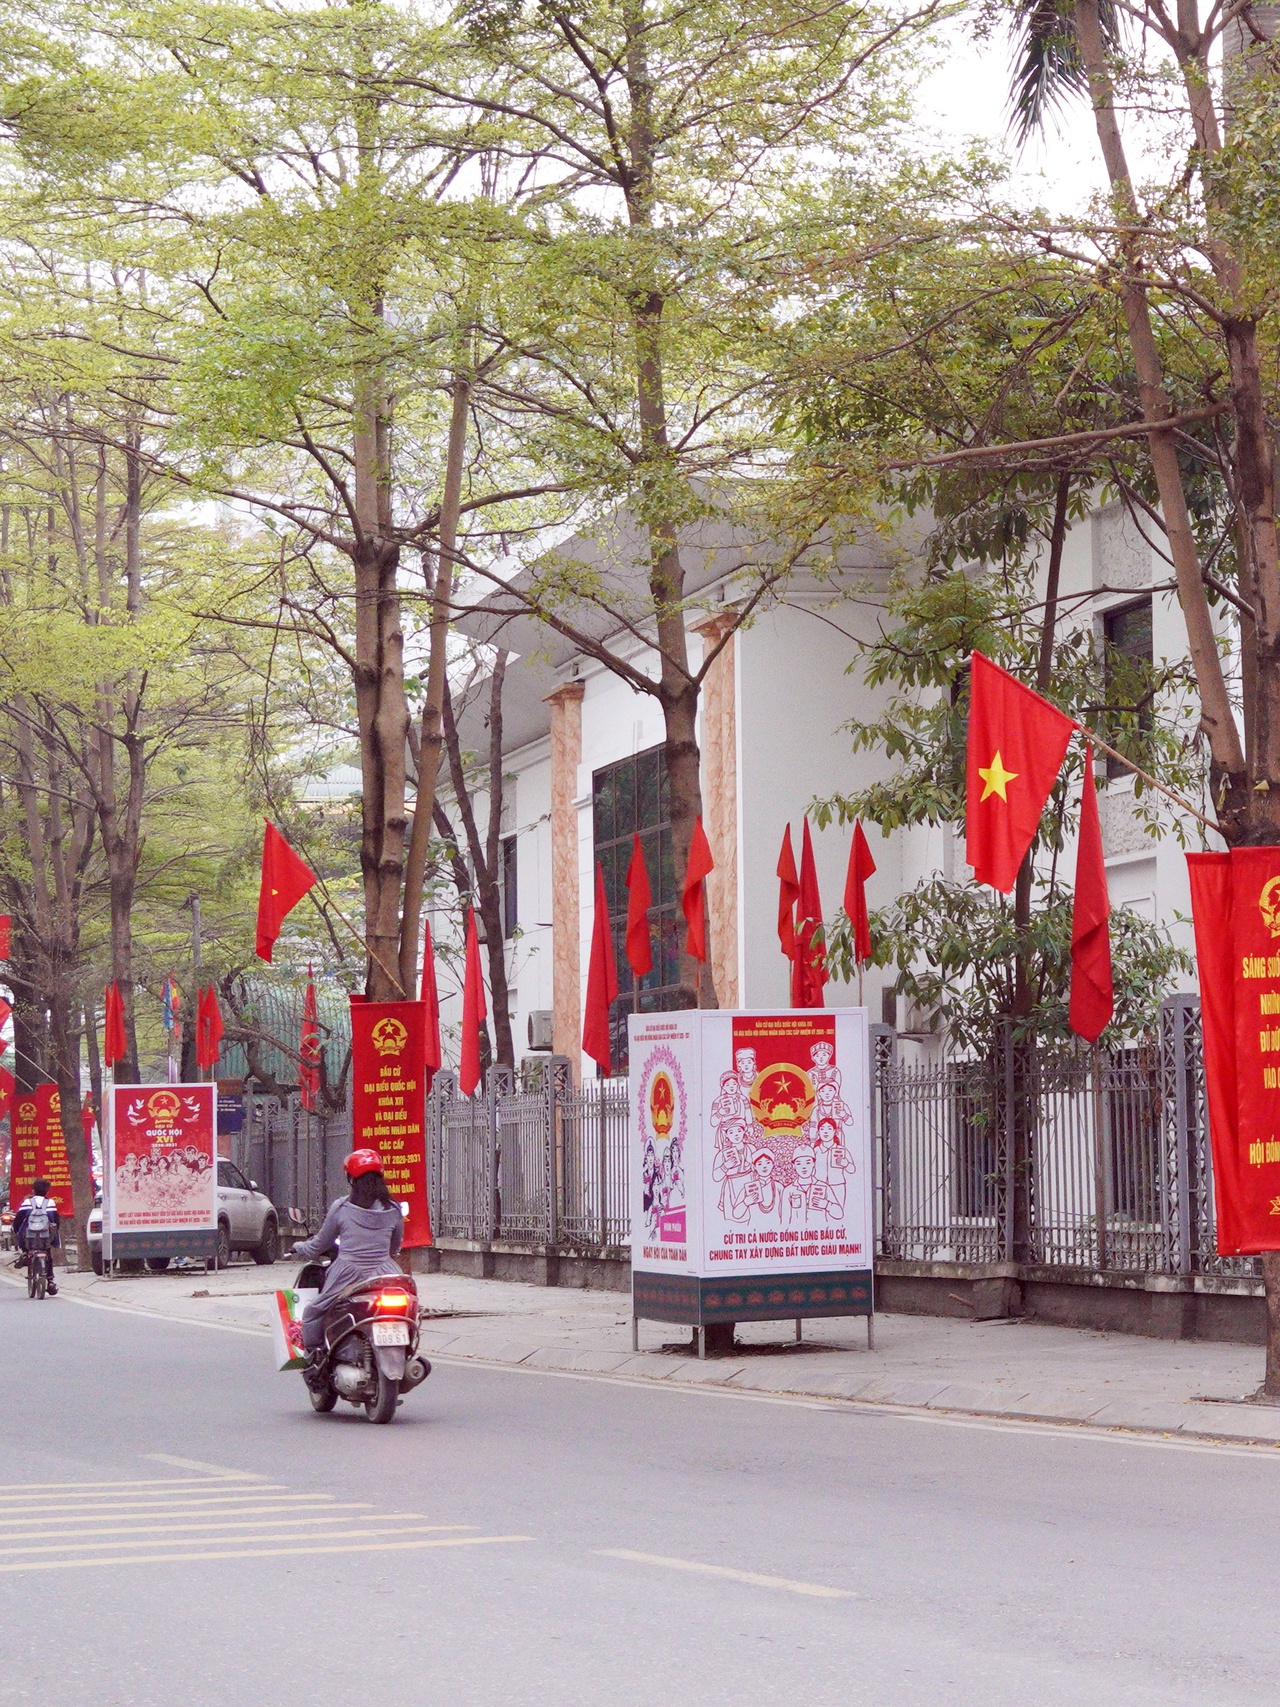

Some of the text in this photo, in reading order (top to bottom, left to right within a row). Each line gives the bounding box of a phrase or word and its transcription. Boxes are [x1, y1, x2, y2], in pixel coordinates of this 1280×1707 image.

[1243, 953, 1266, 978] SÁNG
[1264, 1064, 1277, 1089] VÀO
[1250, 1138, 1264, 1169] HỘI
[724, 1225, 847, 1245] CỬ TRI CẢ NƯỚC ĐỒNG LÒNG BẦU CỬ,
[710, 1243, 862, 1261] CHUNG TAY XÂY DỰNG ĐẤT NƯỚC GIÀU MẠNH!
